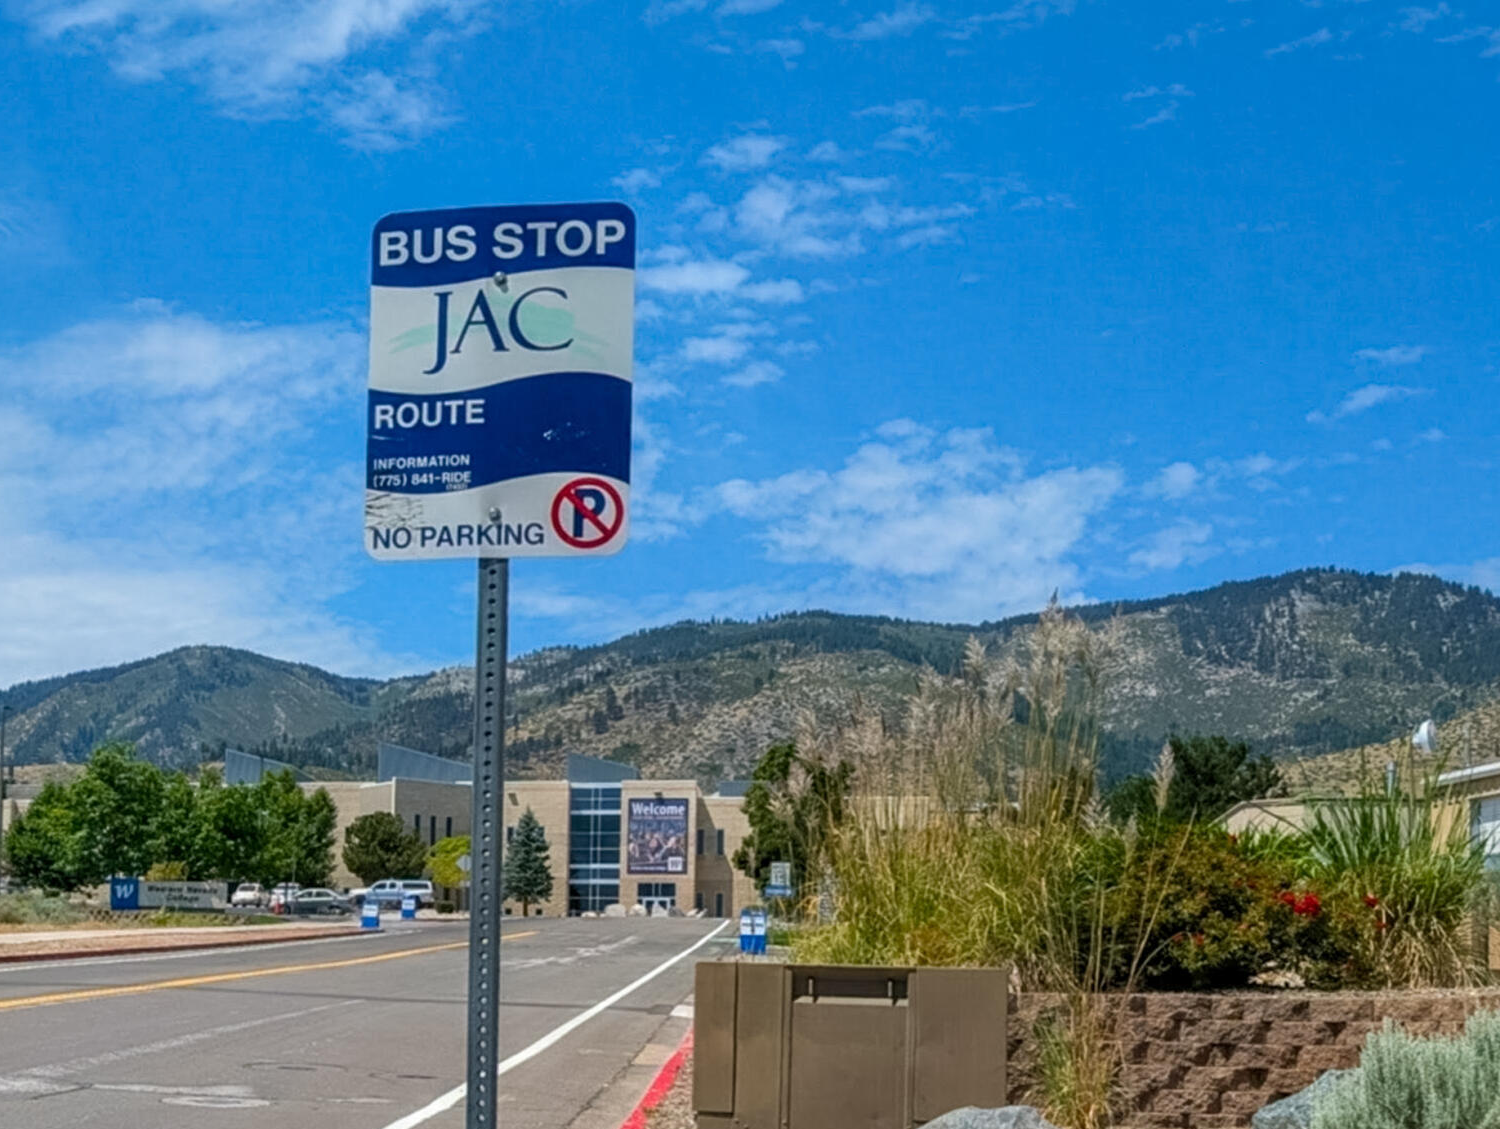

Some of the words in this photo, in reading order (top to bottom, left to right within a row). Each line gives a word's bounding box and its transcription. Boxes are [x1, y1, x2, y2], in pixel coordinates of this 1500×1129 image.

[379, 224, 477, 266] BUS
[492, 219, 626, 259] STOP
[422, 286, 574, 375] JAC
[374, 399, 486, 429] ROUTE
[373, 454, 470, 470] INFORMATION
[373, 473, 407, 488] (775)
[411, 470, 472, 486] 841-RIDE
[372, 527, 412, 549] NO
[420, 522, 545, 548] PARKING
[631, 801, 686, 816] Welcome
